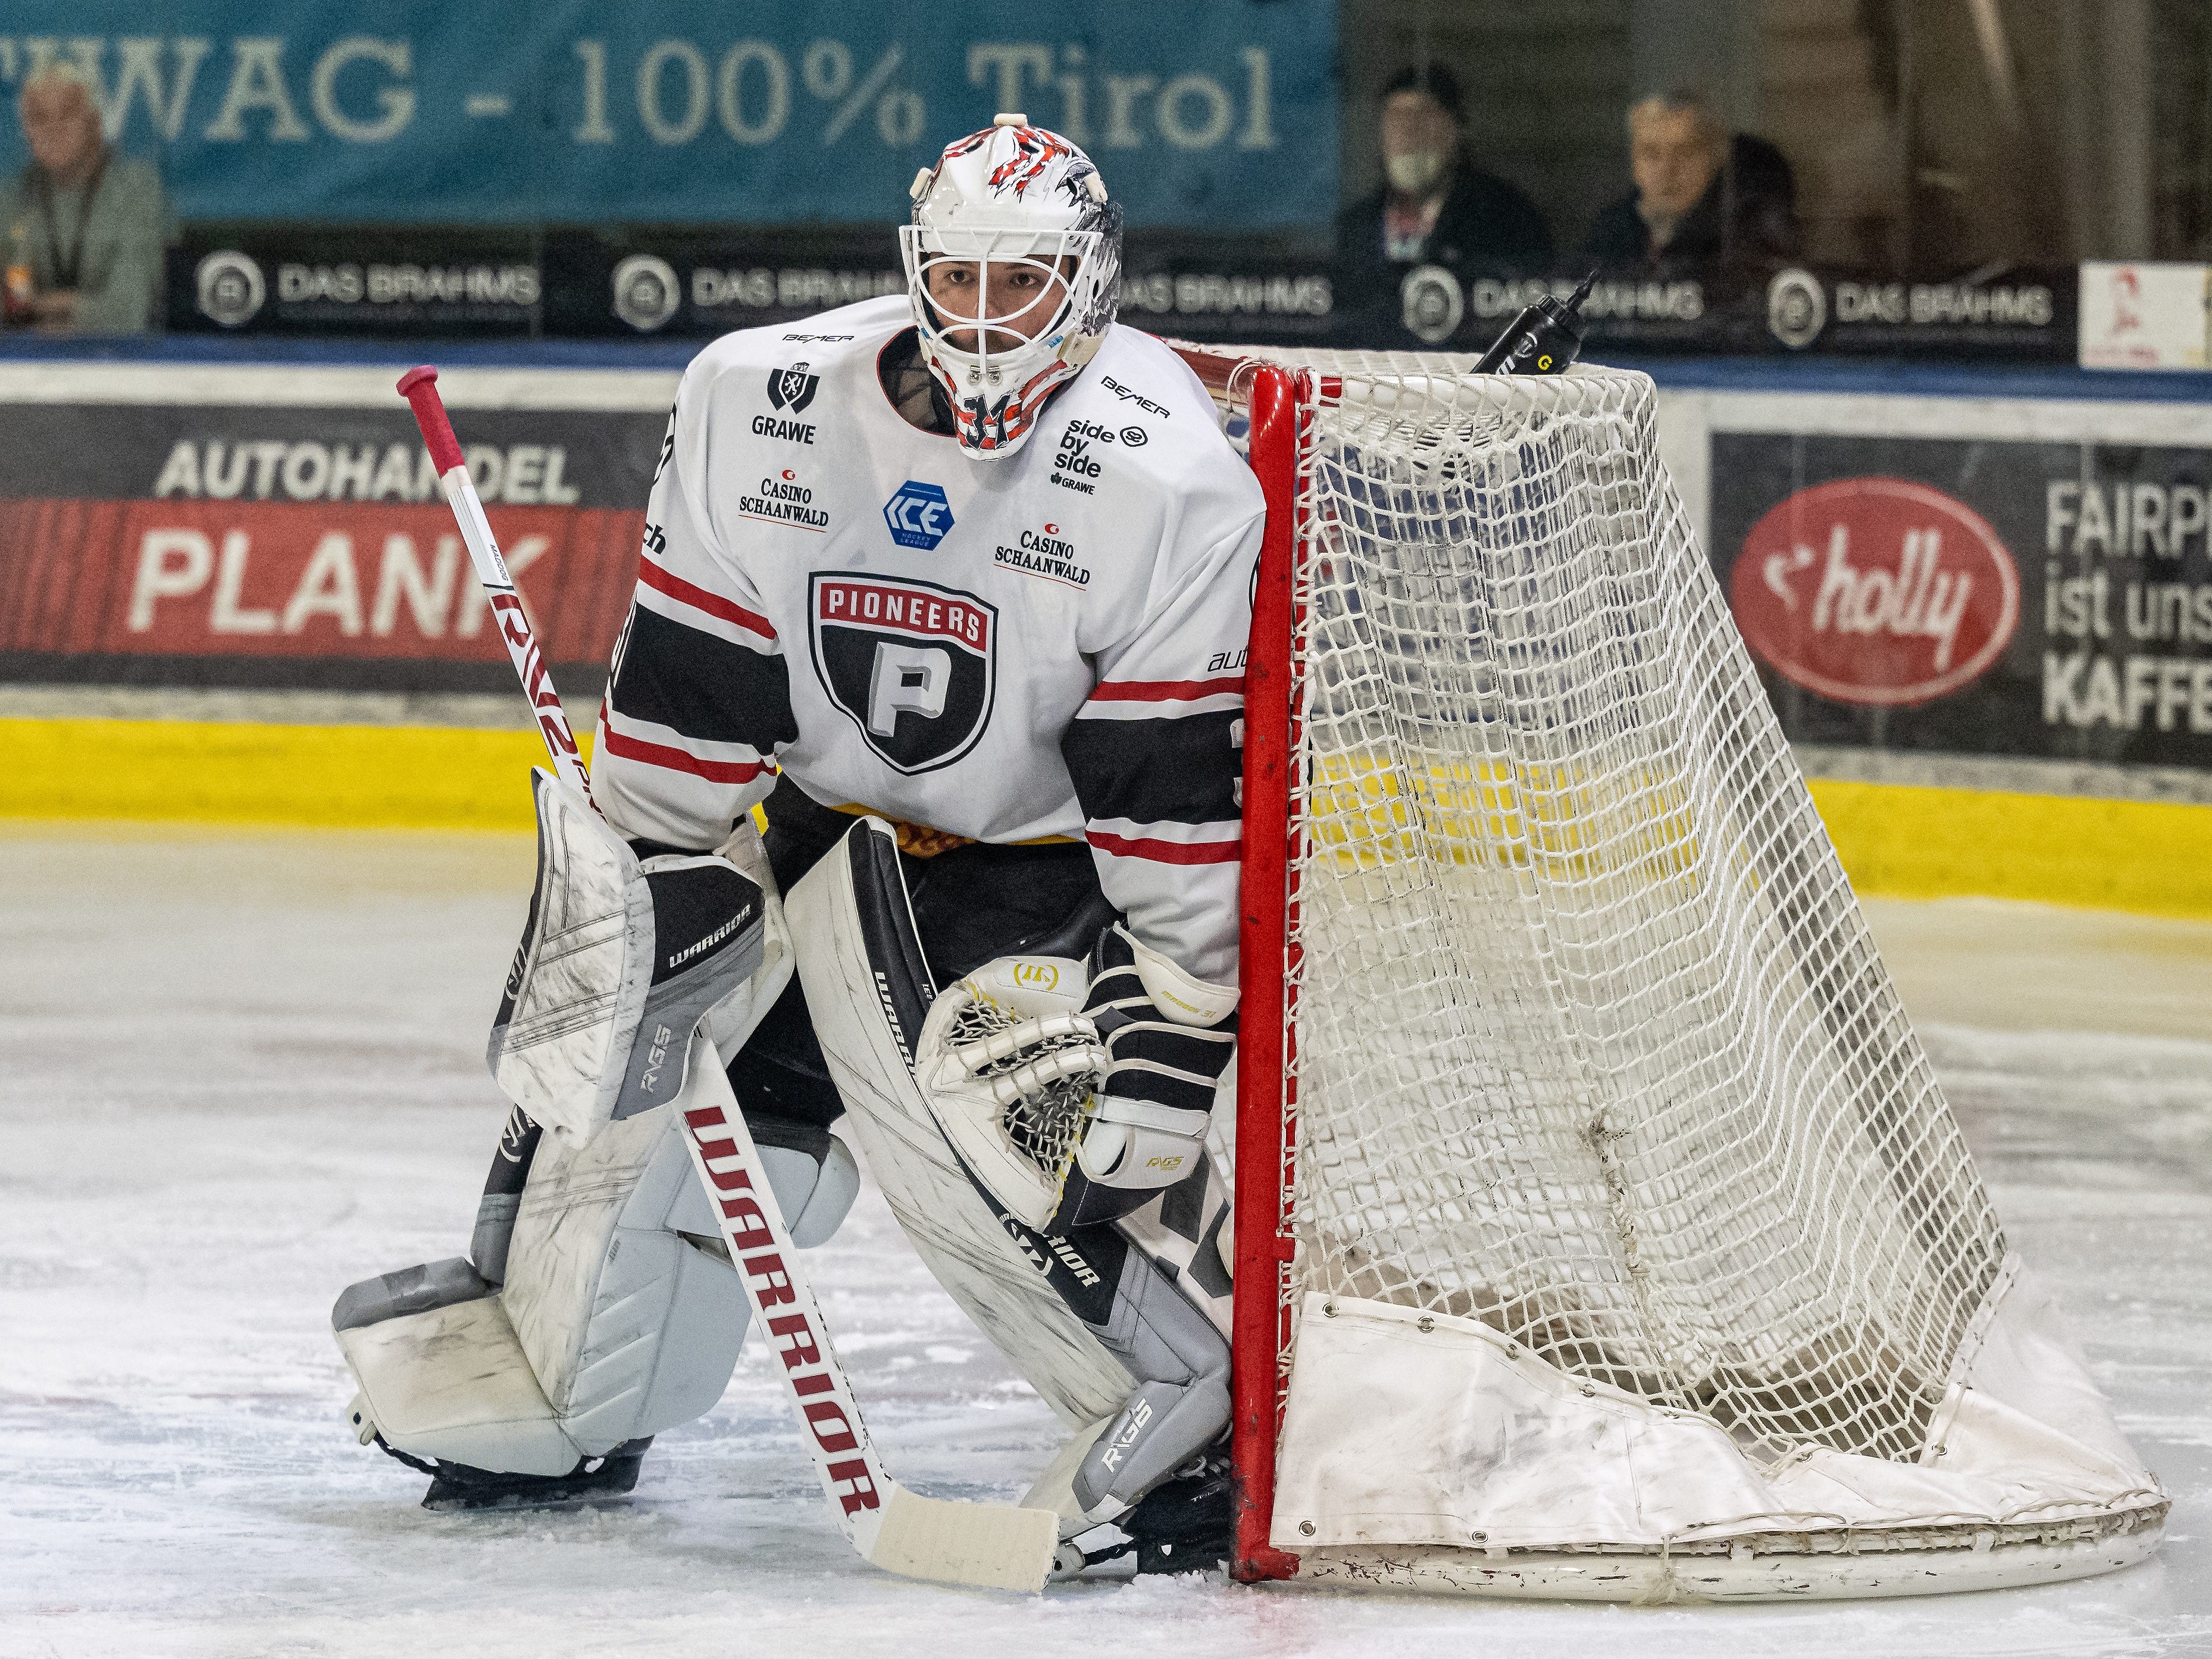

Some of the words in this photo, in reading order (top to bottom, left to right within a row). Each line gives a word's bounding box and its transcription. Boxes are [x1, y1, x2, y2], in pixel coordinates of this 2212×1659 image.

[0, 37, 417, 142] WAG
[573, 37, 926, 146] 100%
[966, 43, 1275, 149] Tirol
[278, 264, 364, 303] DAS
[367, 264, 542, 306] BRAHMS
[692, 268, 778, 308] DAS
[1174, 274, 1333, 315] BRAHMS
[1835, 282, 1904, 323] DAS
[1907, 283, 2054, 327] BRAHMS
[783, 334, 855, 343] BEMER
[1101, 375, 1171, 418] BEMER
[752, 415, 816, 445] GRAWE
[963, 394, 1012, 451] 31
[1068, 420, 1115, 443] side
[1060, 431, 1090, 457] by
[1054, 453, 1102, 478] side
[1062, 477, 1095, 495] GRAWE
[739, 496, 829, 527] SCHAANWALD
[761, 478, 812, 504] CASINO
[887, 496, 948, 536] ICE
[2046, 479, 2212, 561] FAIRP
[1020, 530, 1074, 559] CASINO
[128, 526, 552, 641] PLANK
[994, 546, 1090, 585] SCHAANWALD
[829, 589, 980, 642] PIONEERS
[1812, 522, 1972, 675] holly
[2045, 558, 2114, 638] ist
[868, 641, 952, 738] P
[669, 904, 751, 968] WARRIOR
[683, 1106, 881, 1519] WARRIOR
